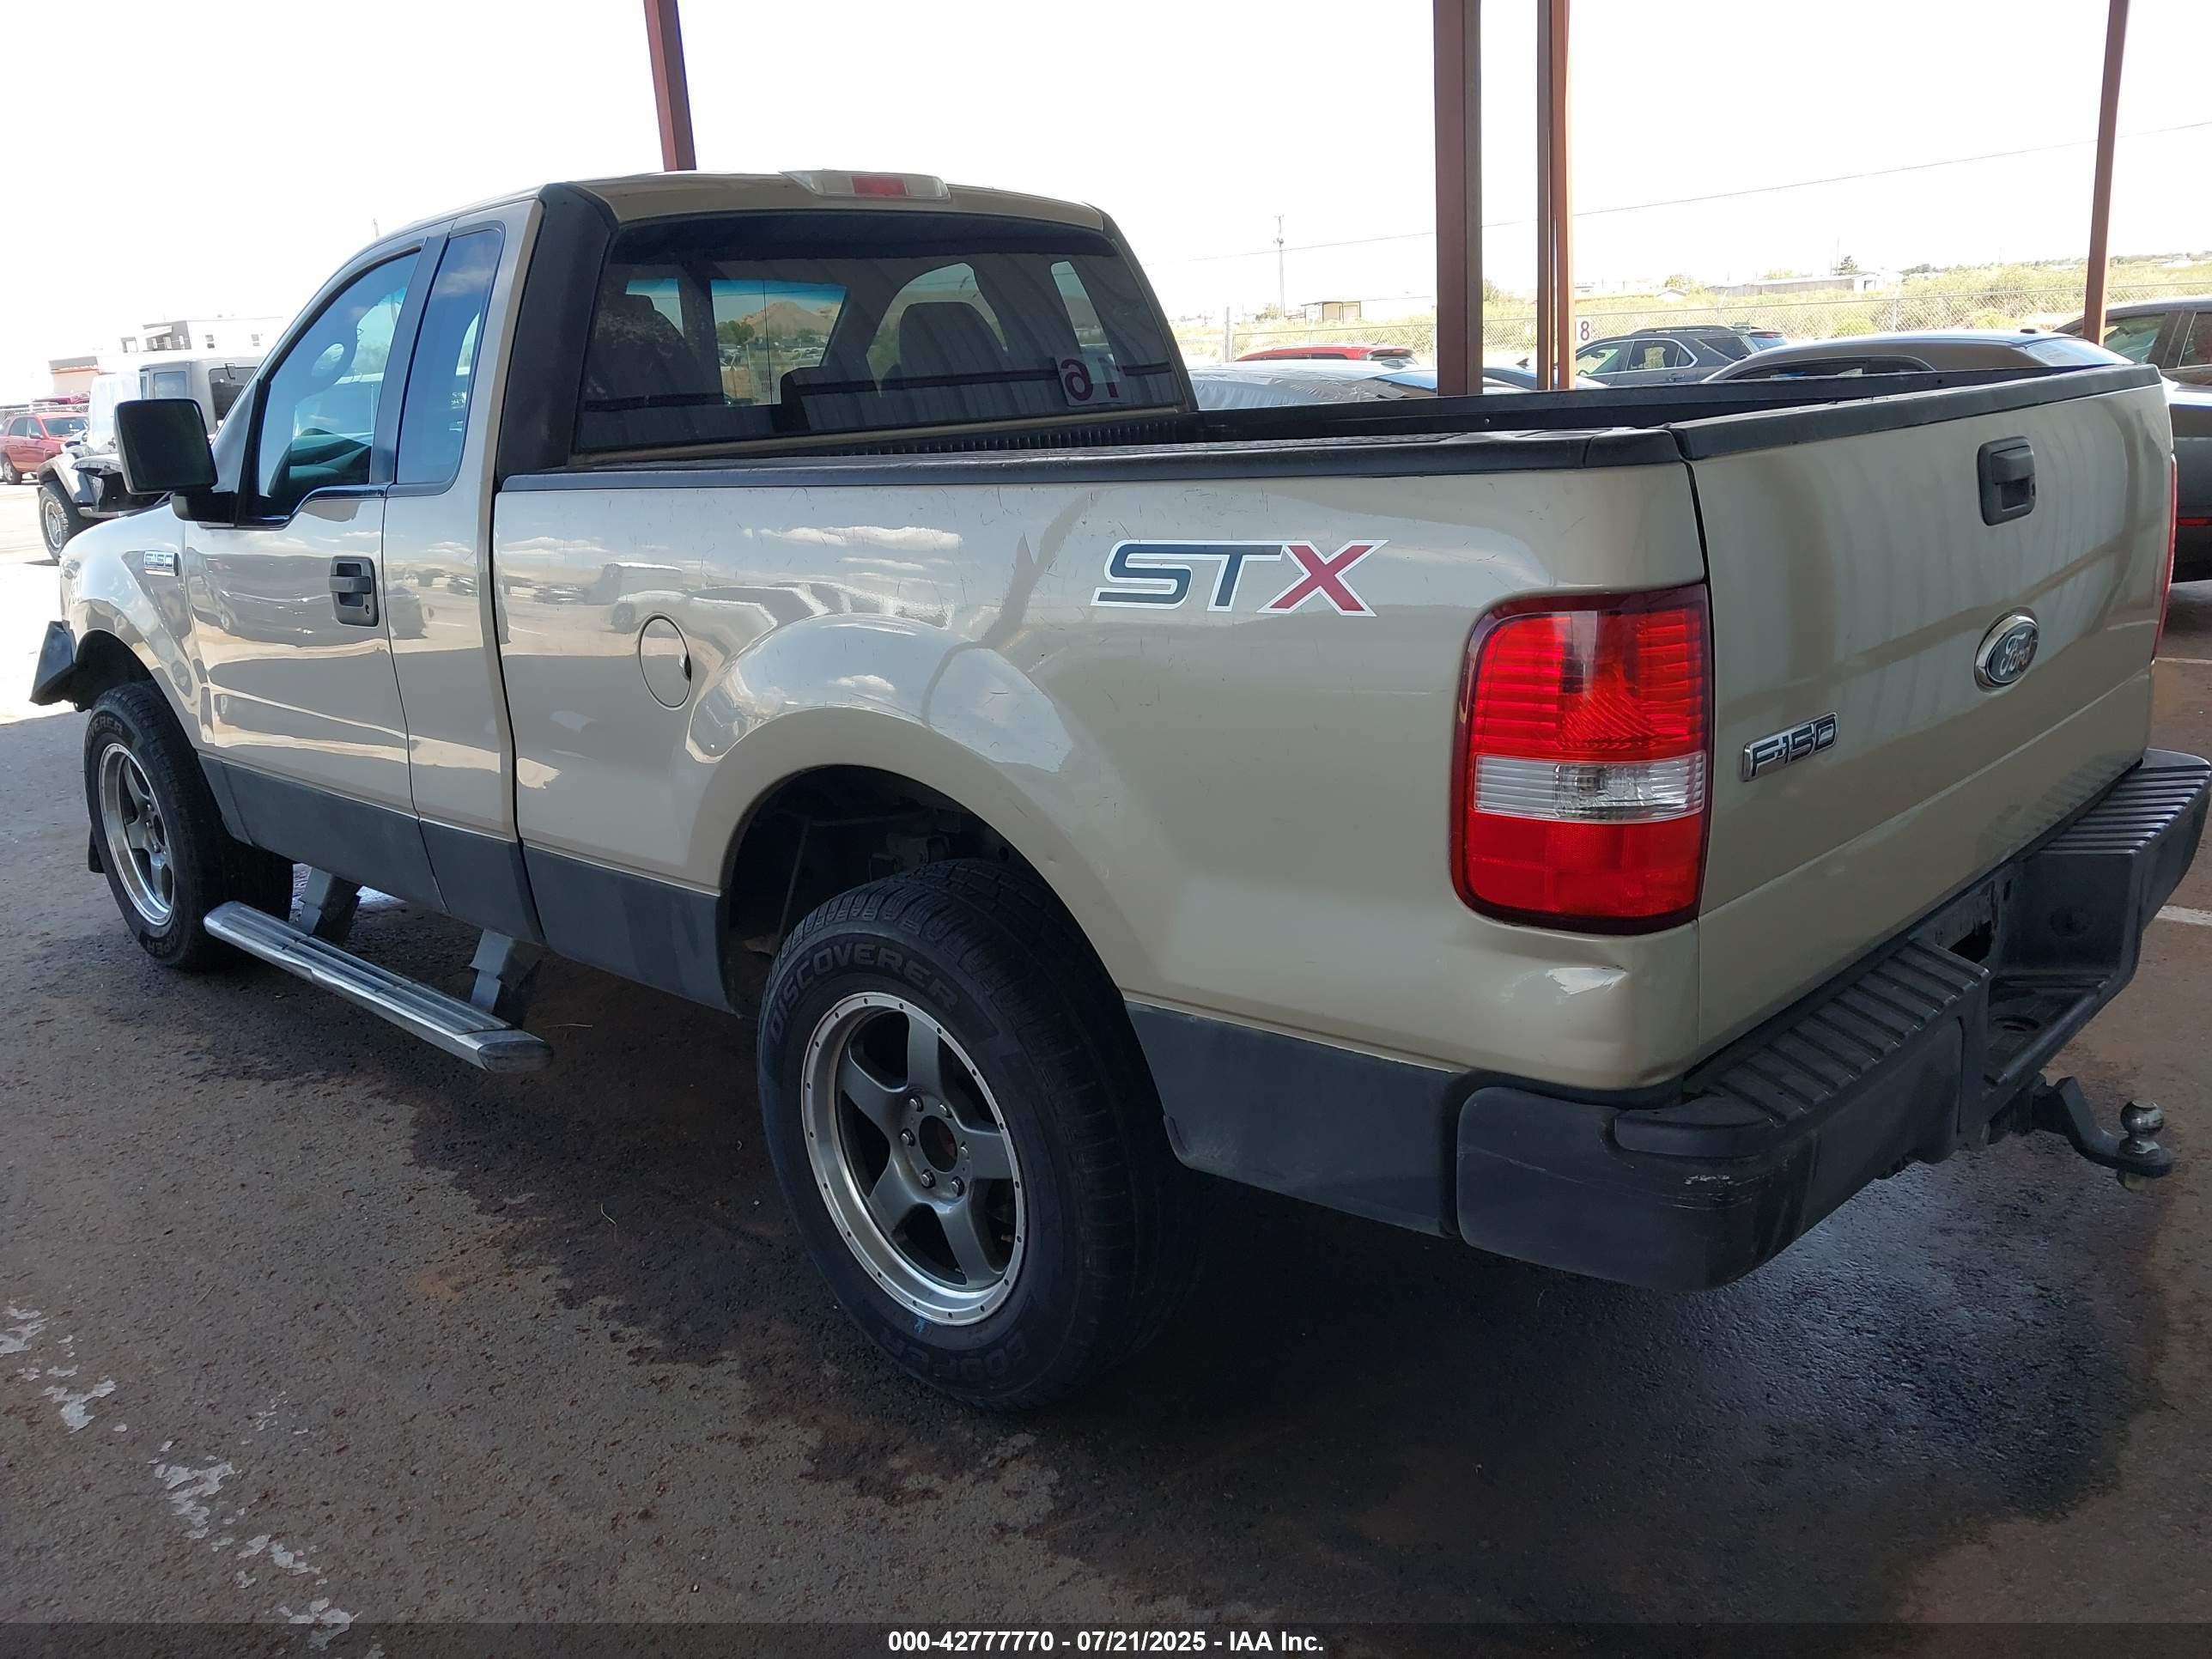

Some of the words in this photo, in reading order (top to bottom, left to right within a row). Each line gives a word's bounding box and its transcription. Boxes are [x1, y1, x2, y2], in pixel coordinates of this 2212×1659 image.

[1091, 539, 1389, 617] STX
[1999, 632, 2034, 676] Ford
[769, 943, 960, 1042] DISCOVERER
